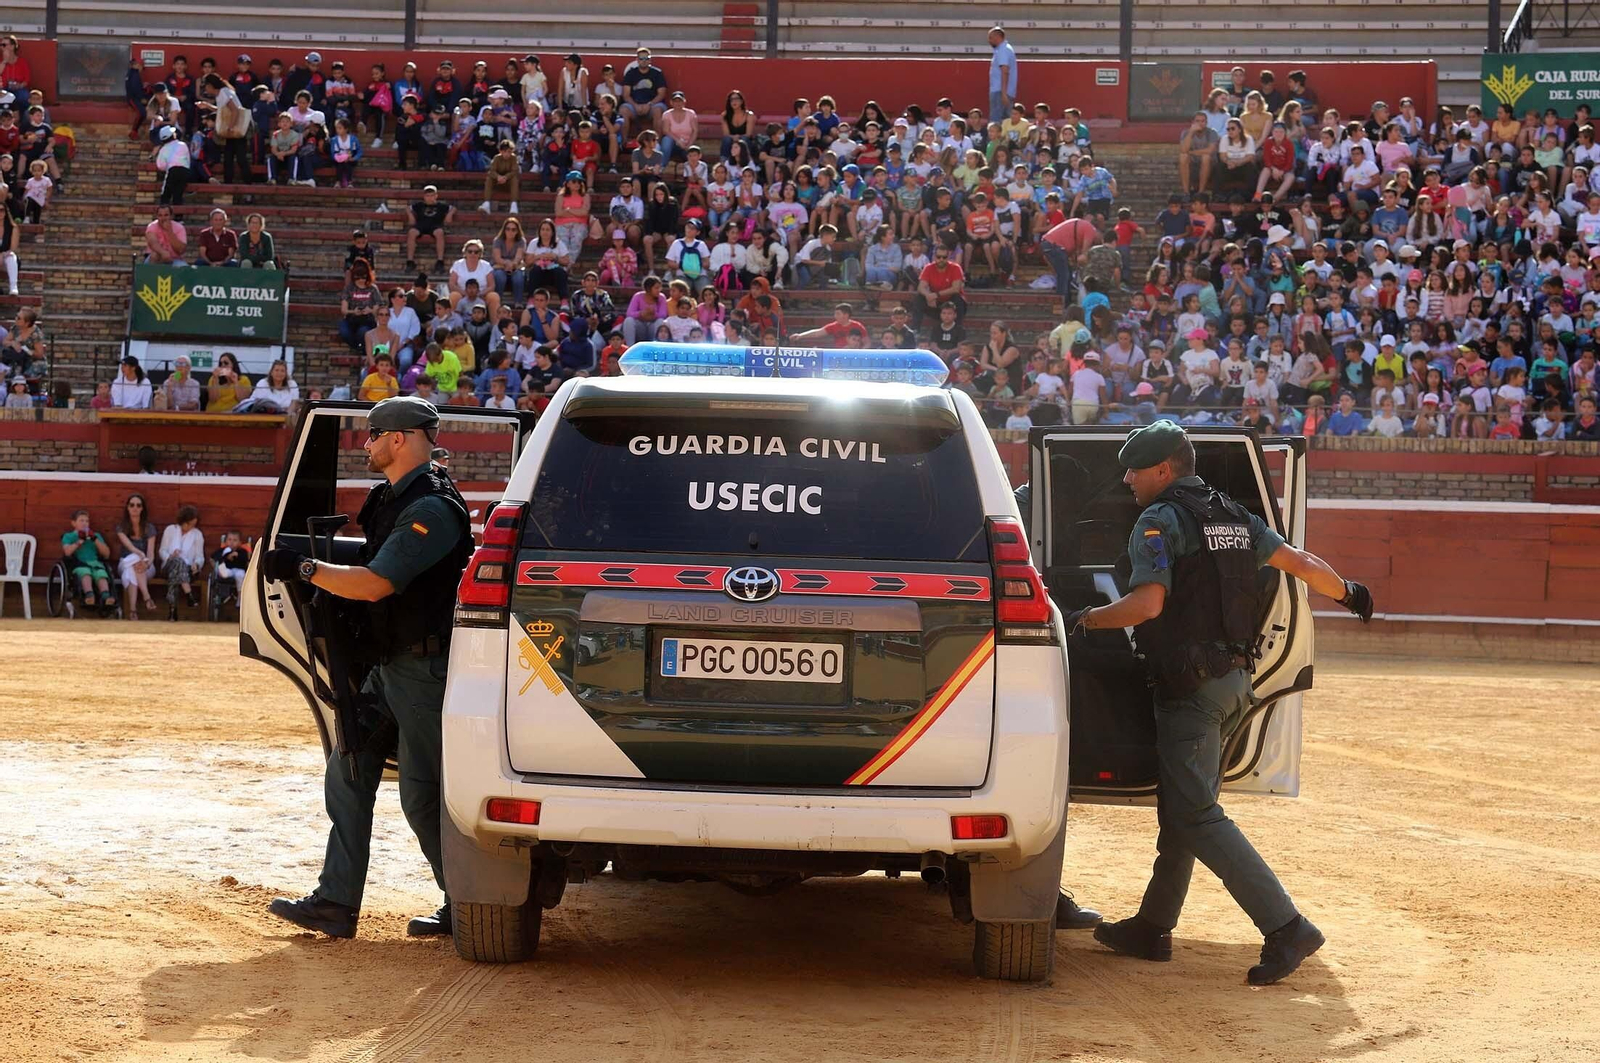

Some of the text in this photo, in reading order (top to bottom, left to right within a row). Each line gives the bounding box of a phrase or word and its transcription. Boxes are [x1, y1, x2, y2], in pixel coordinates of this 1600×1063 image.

[1534, 71, 1568, 83] CAJA
[1549, 90, 1573, 100] DEL
[192, 285, 279, 301] CAJA RURAL
[206, 305, 263, 317] DEL SUR
[751, 348, 818, 358] GUARDIA
[628, 435, 887, 463] GUARDIA CIVIL
[688, 481, 822, 515] USECIC
[1204, 526, 1250, 536] GUARDIA CIVIL
[648, 604, 854, 626] LAND CRUISER
[682, 644, 736, 673] PGC
